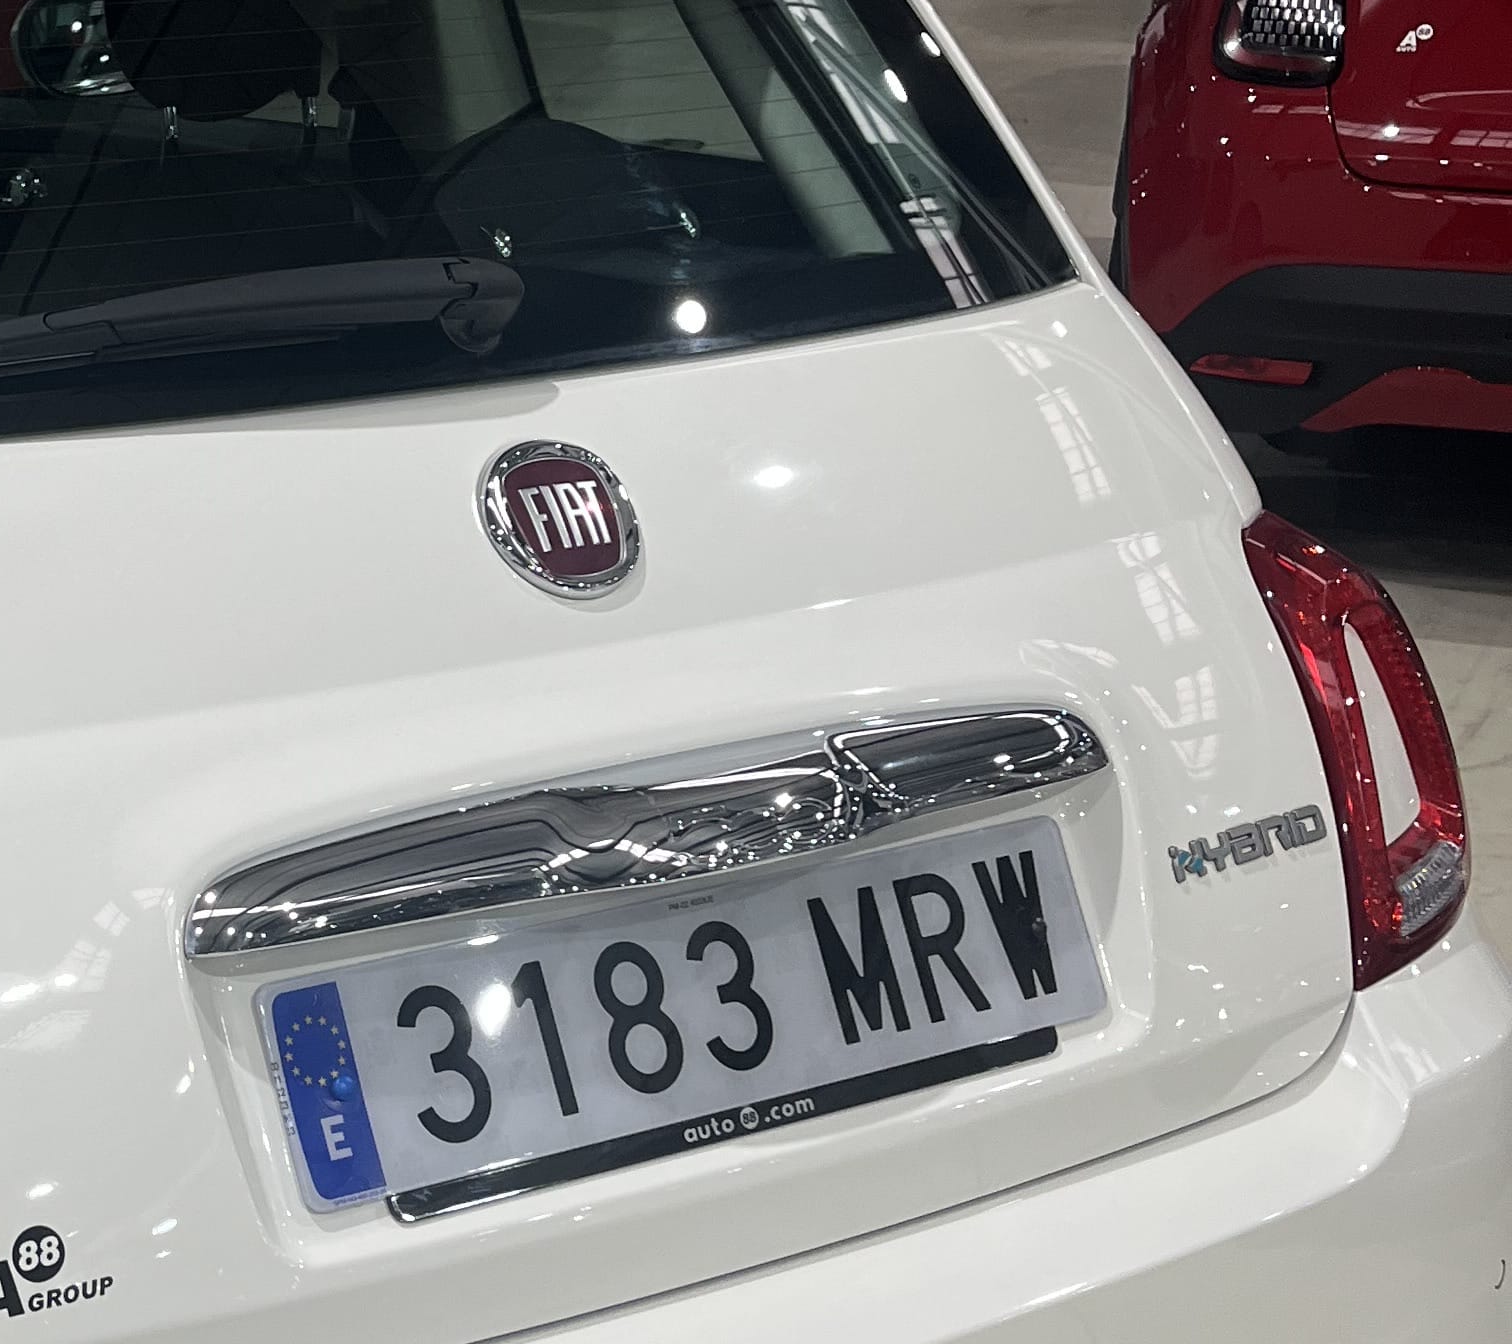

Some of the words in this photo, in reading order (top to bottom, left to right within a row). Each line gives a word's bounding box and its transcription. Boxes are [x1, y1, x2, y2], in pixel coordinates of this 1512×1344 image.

[517, 479, 612, 553] FIAT
[1167, 803, 1328, 884] HYBRID
[396, 920, 774, 1144] 3183
[806, 850, 1058, 1046] MRW
[320, 1113, 354, 1162] E
[17, 1234, 62, 1273] 88
[28, 1276, 114, 1312] GROUP
